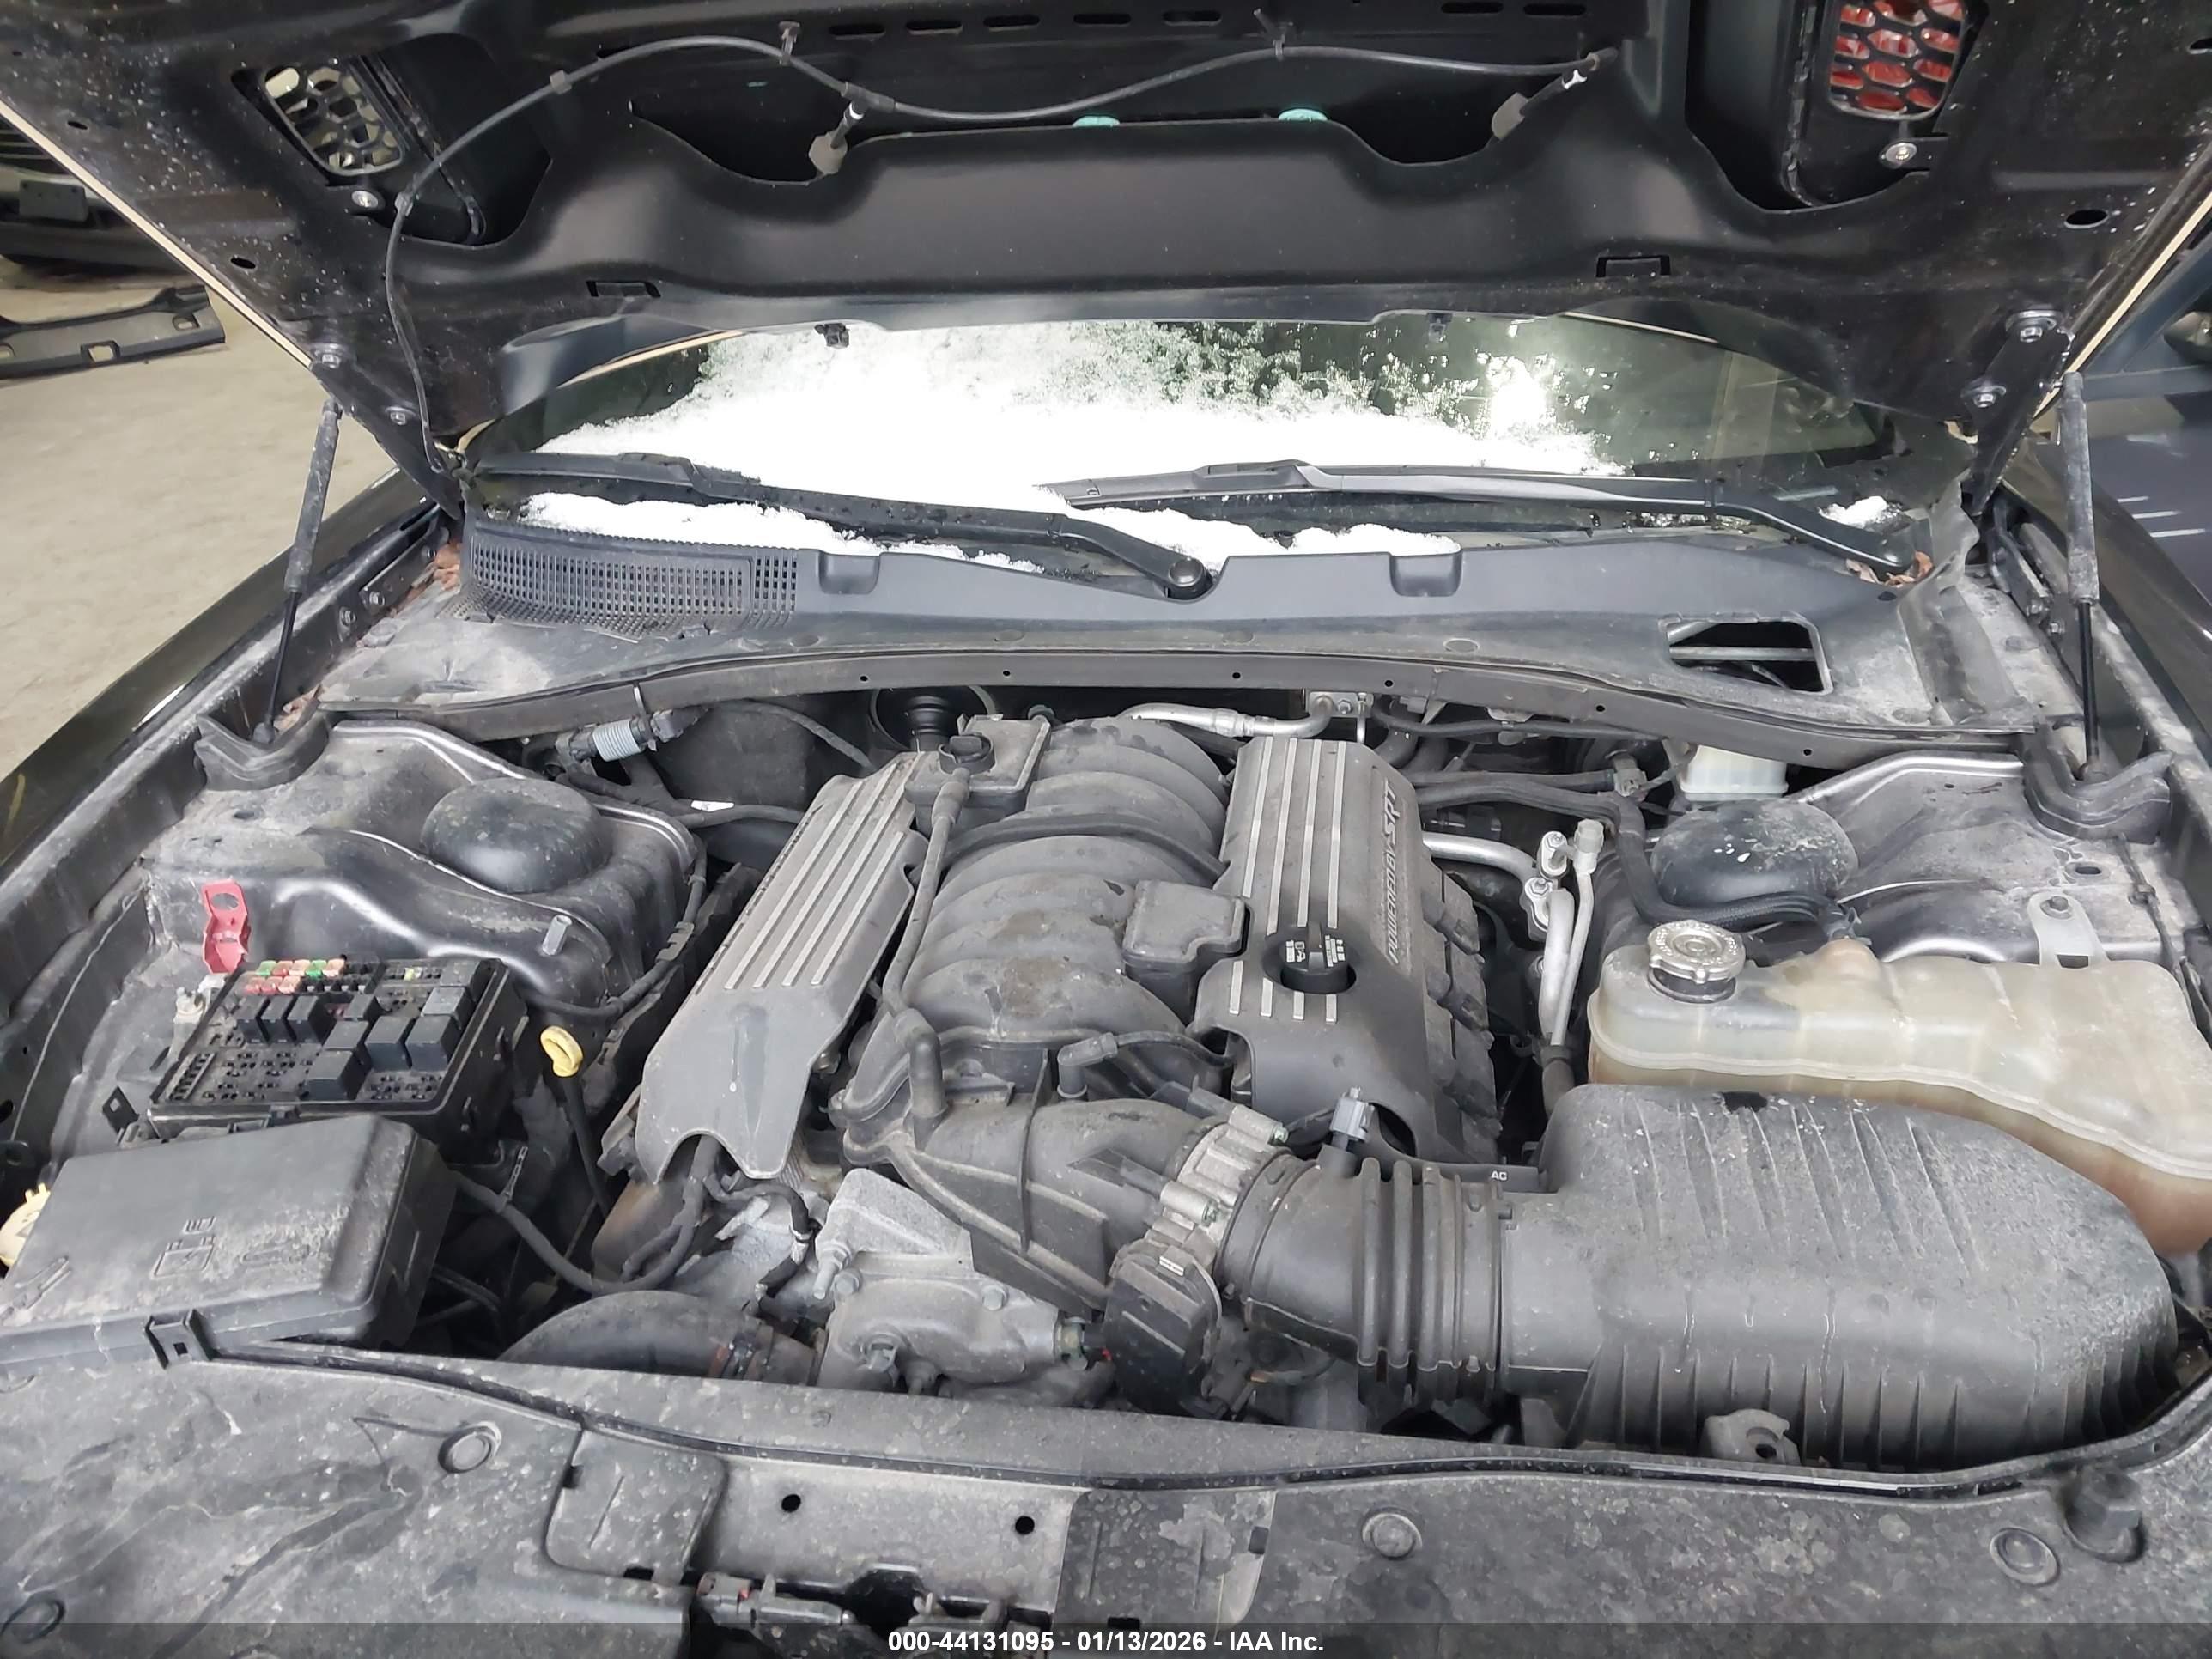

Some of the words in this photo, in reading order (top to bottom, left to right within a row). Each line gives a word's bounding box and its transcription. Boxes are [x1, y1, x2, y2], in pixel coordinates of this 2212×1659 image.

[1384, 778, 1401, 845] SRT
[1385, 842, 1396, 871] BY
[1385, 871, 1400, 963] POWERED
